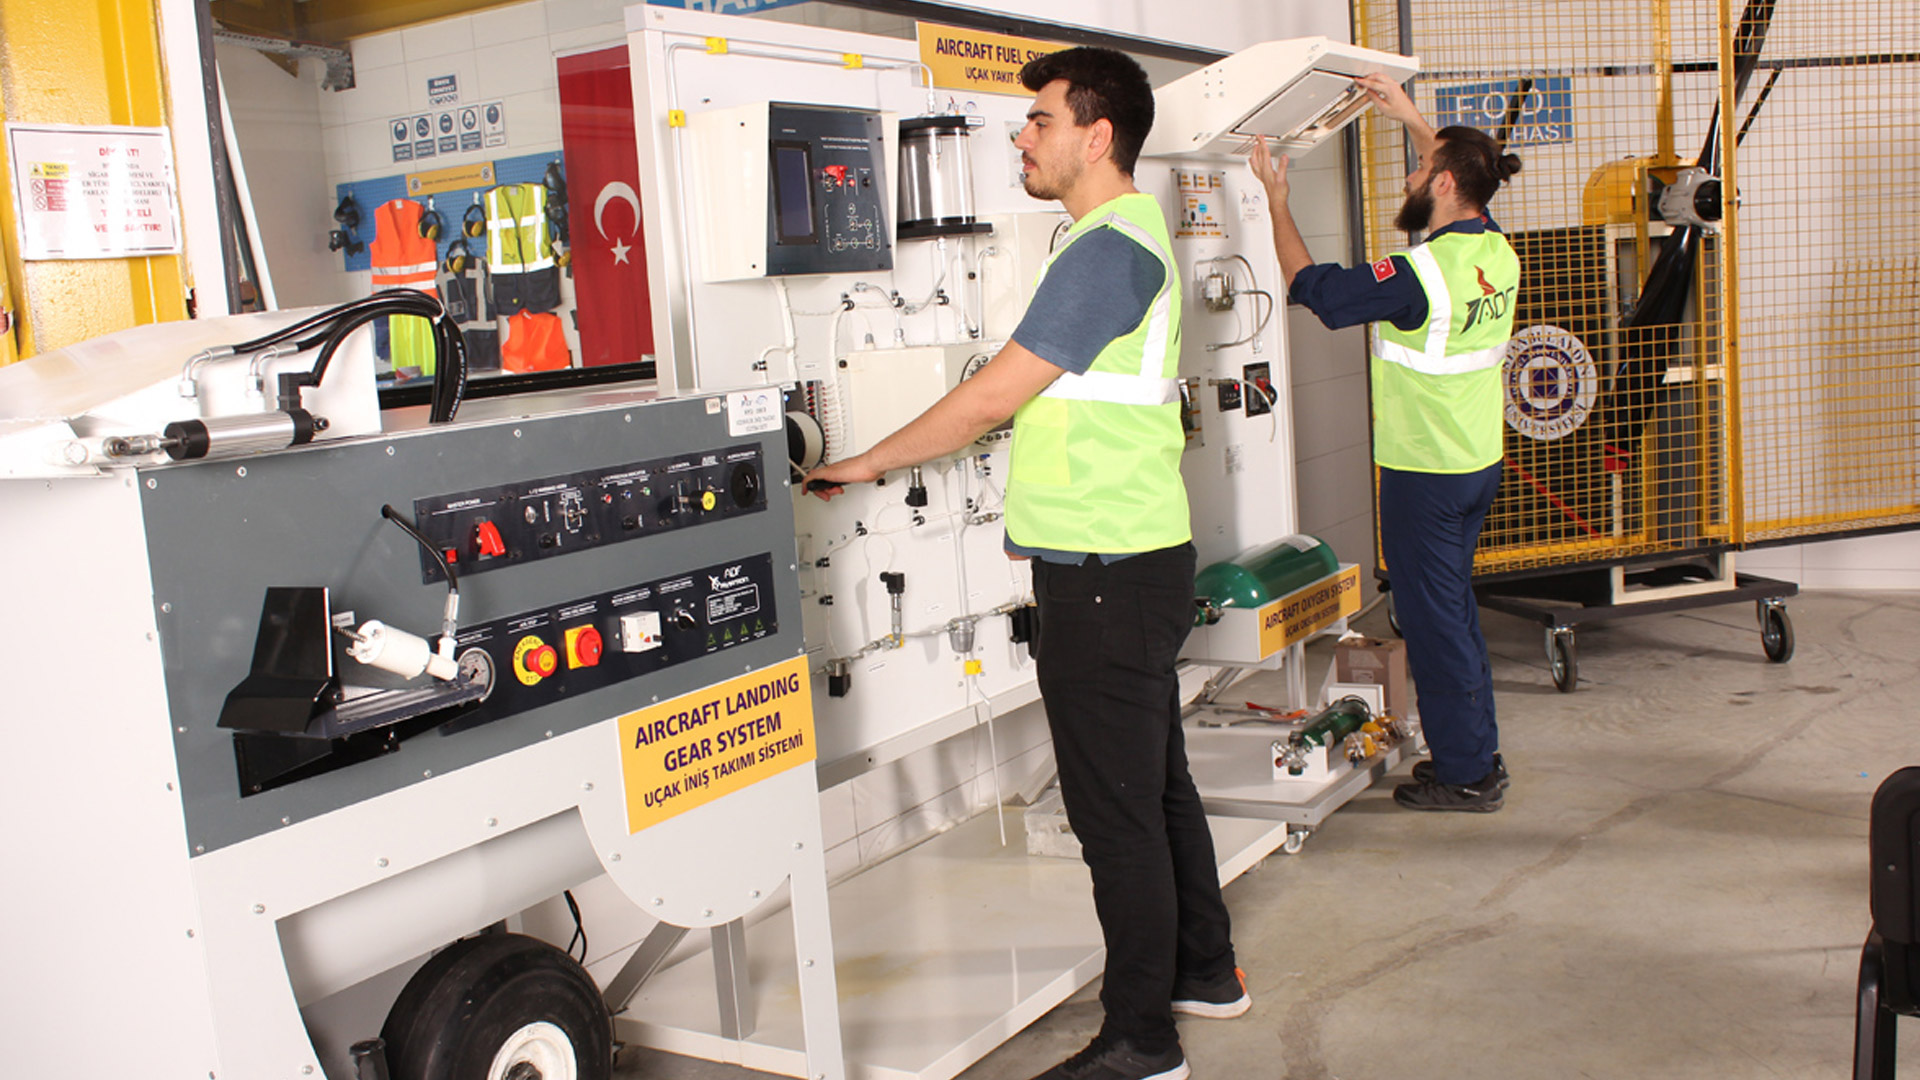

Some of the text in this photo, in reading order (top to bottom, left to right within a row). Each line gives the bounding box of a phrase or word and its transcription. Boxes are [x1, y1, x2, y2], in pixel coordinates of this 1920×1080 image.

[936, 37, 994, 61] AIRCRAFT
[996, 46, 1024, 65] FUEL
[965, 67, 989, 83] UÇAK
[991, 69, 1014, 84] YAKIT
[1264, 574, 1356, 631] AIRCRAFT OXYGEN SYSTEM
[634, 672, 799, 749] AIRCRAFT LANDING
[644, 729, 804, 808] UÇAK İNİŞ TAKIMI SİSTEMİ
[663, 711, 782, 772] GEAR SYSTEM
